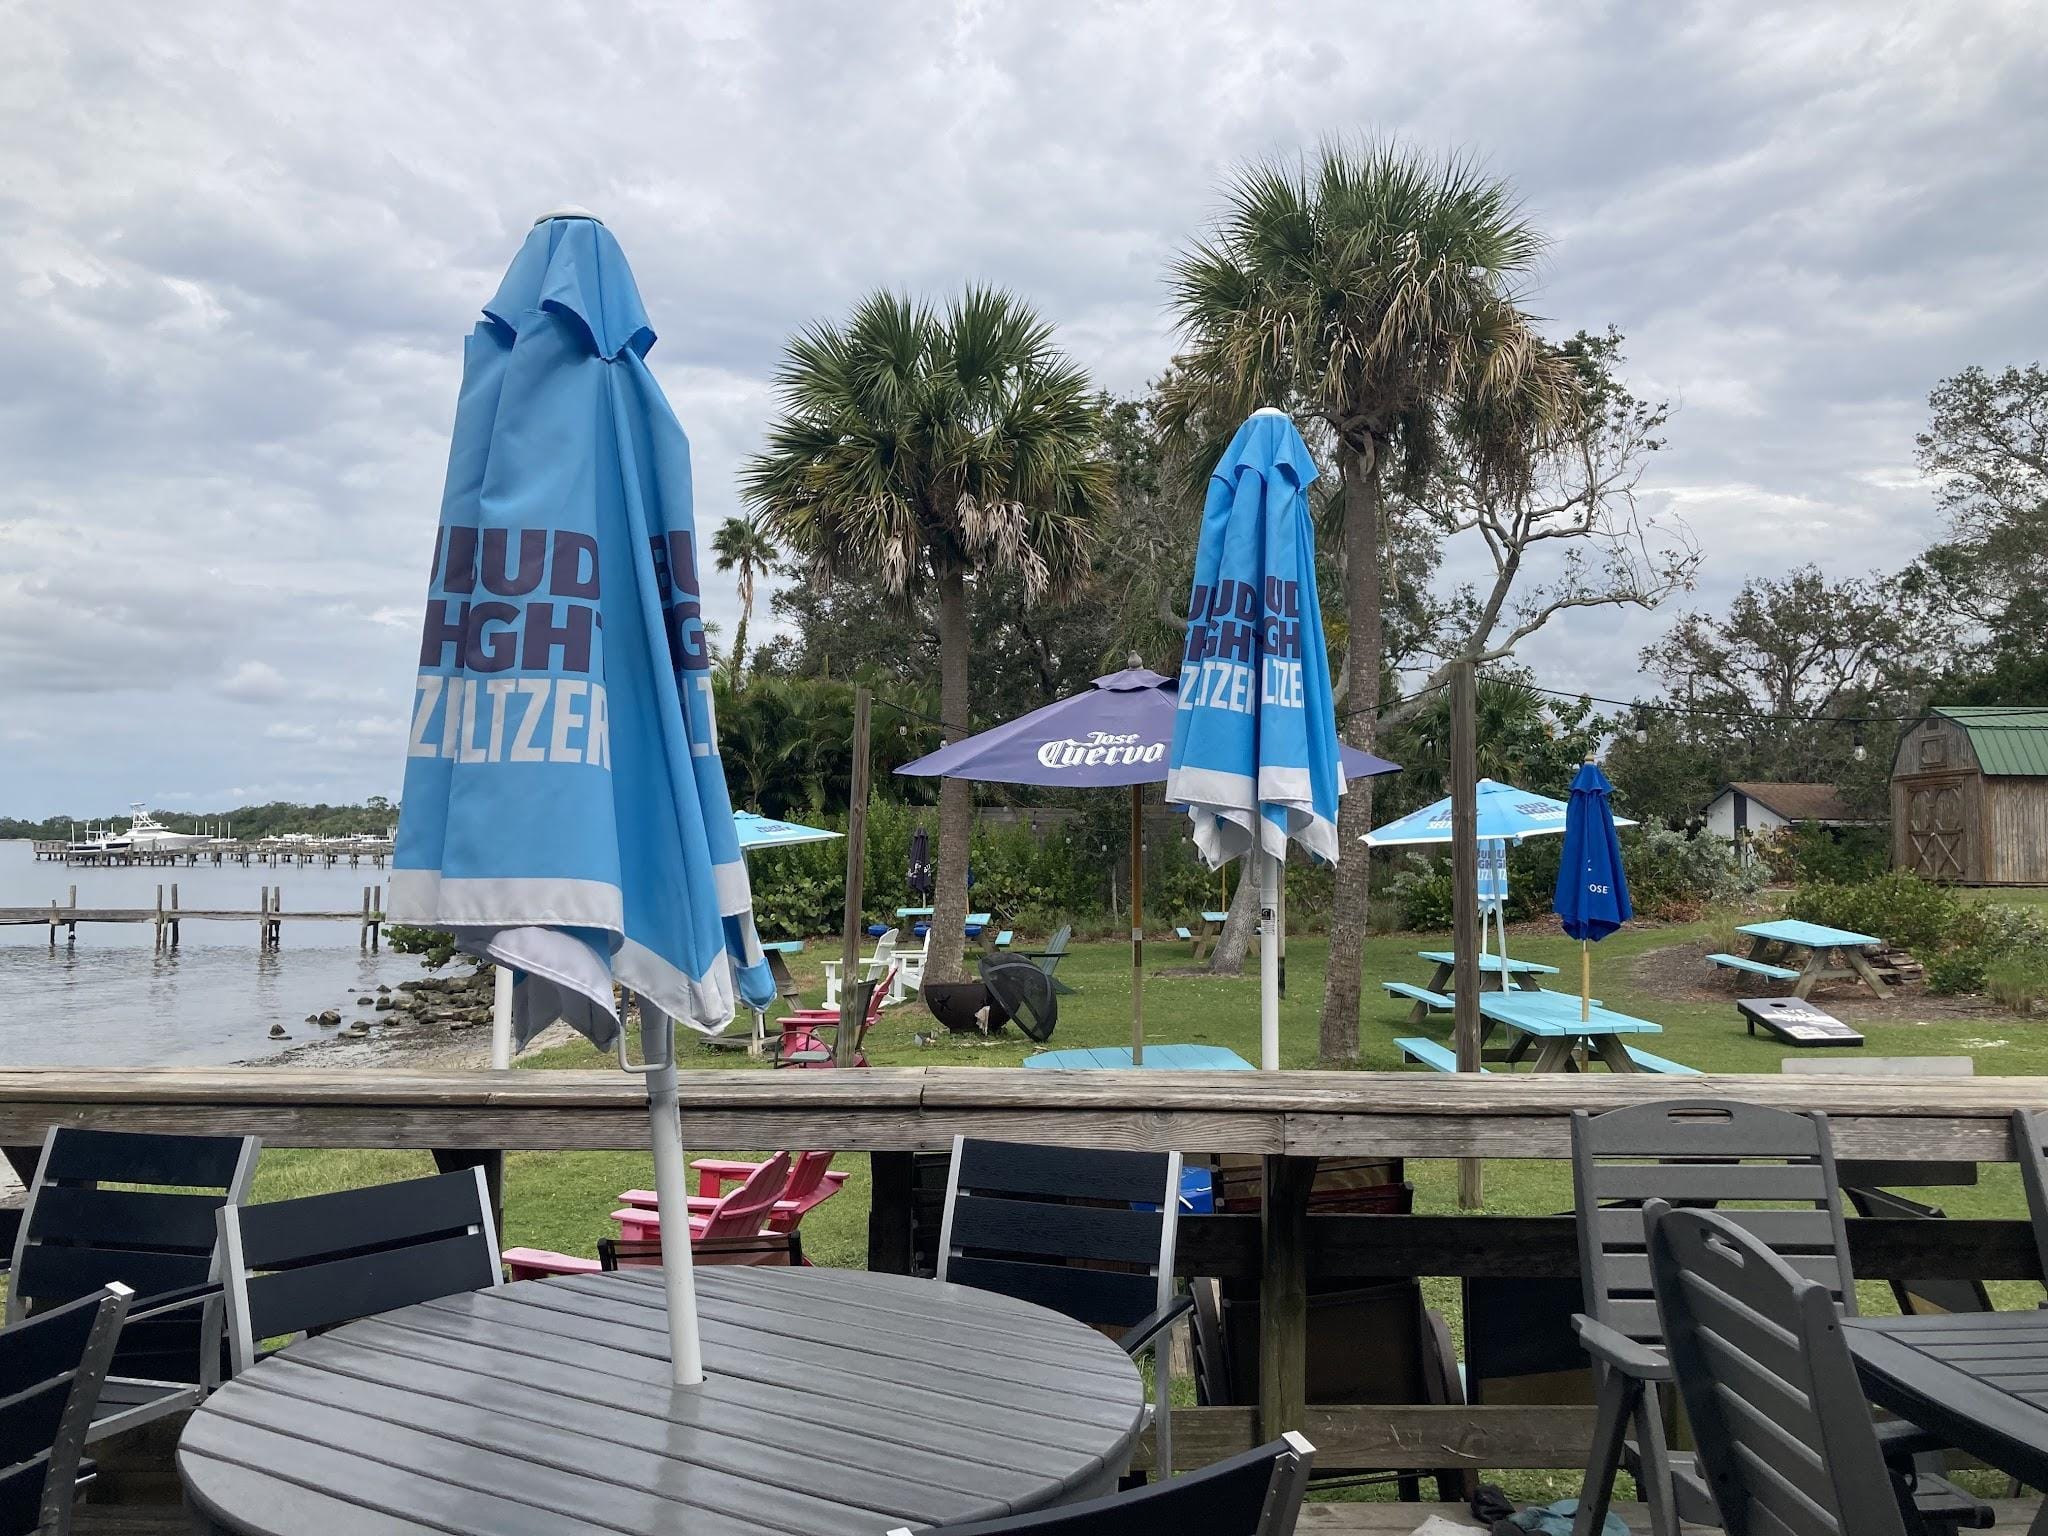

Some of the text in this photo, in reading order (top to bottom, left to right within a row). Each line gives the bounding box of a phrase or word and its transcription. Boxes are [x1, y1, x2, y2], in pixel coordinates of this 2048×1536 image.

[1086, 731, 1141, 746] Jose
[1037, 739, 1166, 768] Cuervo
[1590, 884, 1608, 894] OSE
